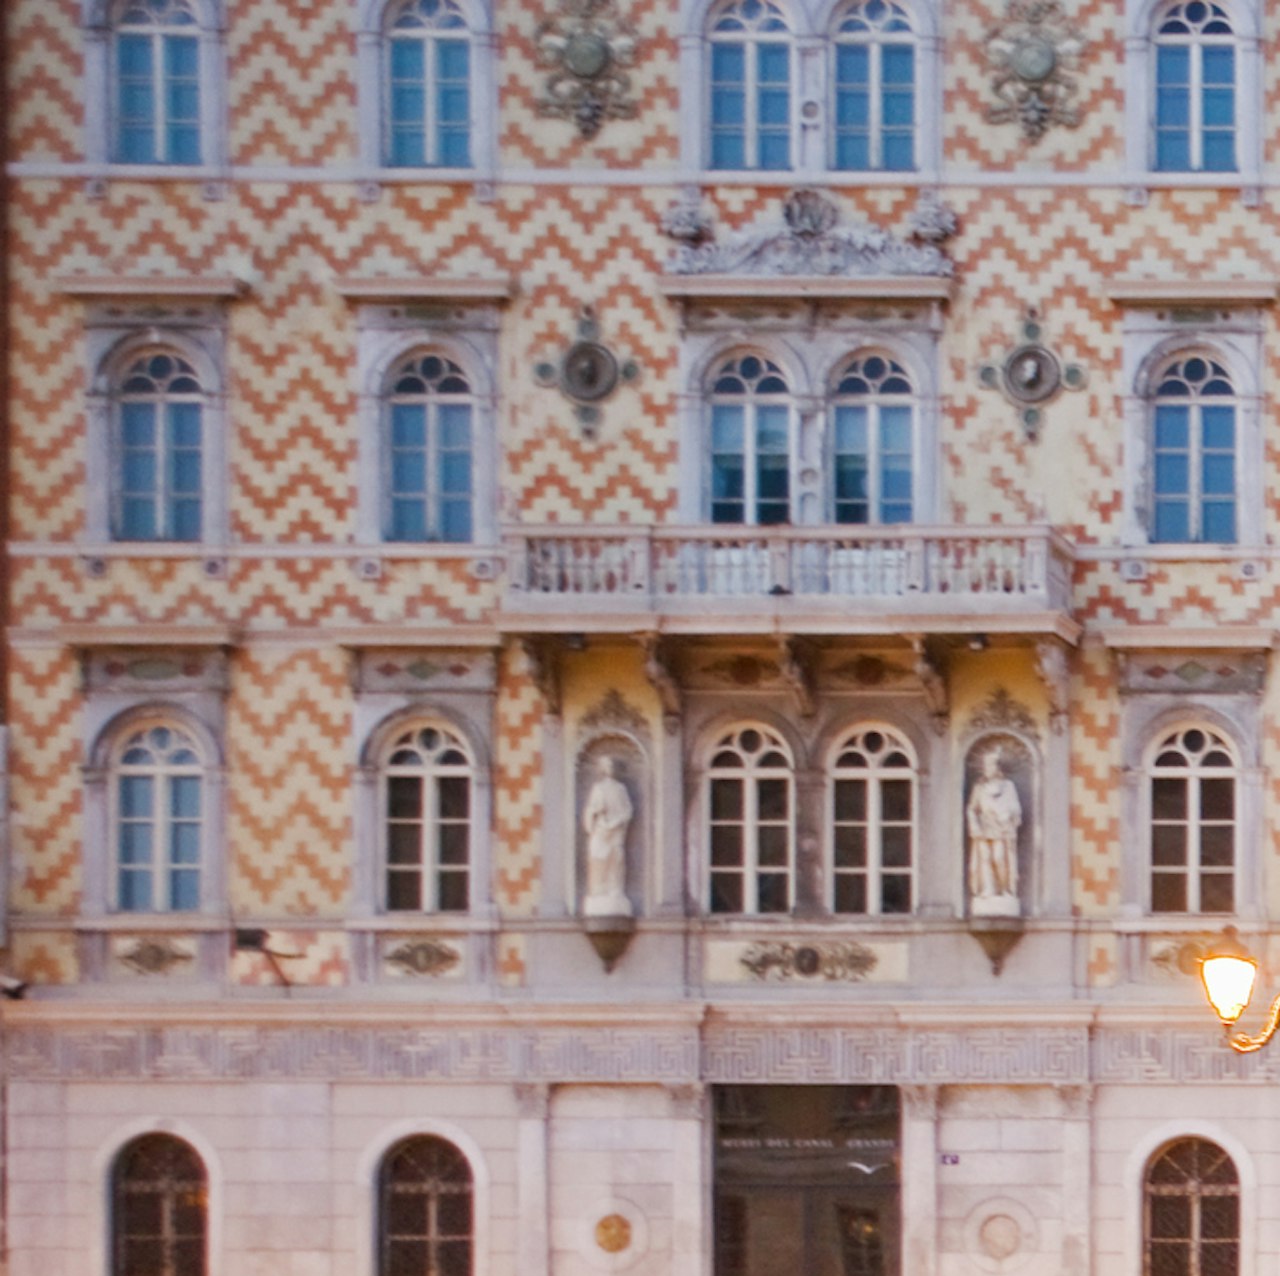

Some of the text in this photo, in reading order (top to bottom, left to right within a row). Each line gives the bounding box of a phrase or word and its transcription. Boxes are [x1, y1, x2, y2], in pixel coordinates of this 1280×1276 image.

[764, 1138, 790, 1148] DEL
[793, 1138, 834, 1148] CANAL
[846, 1138, 895, 1148] GRANDE
